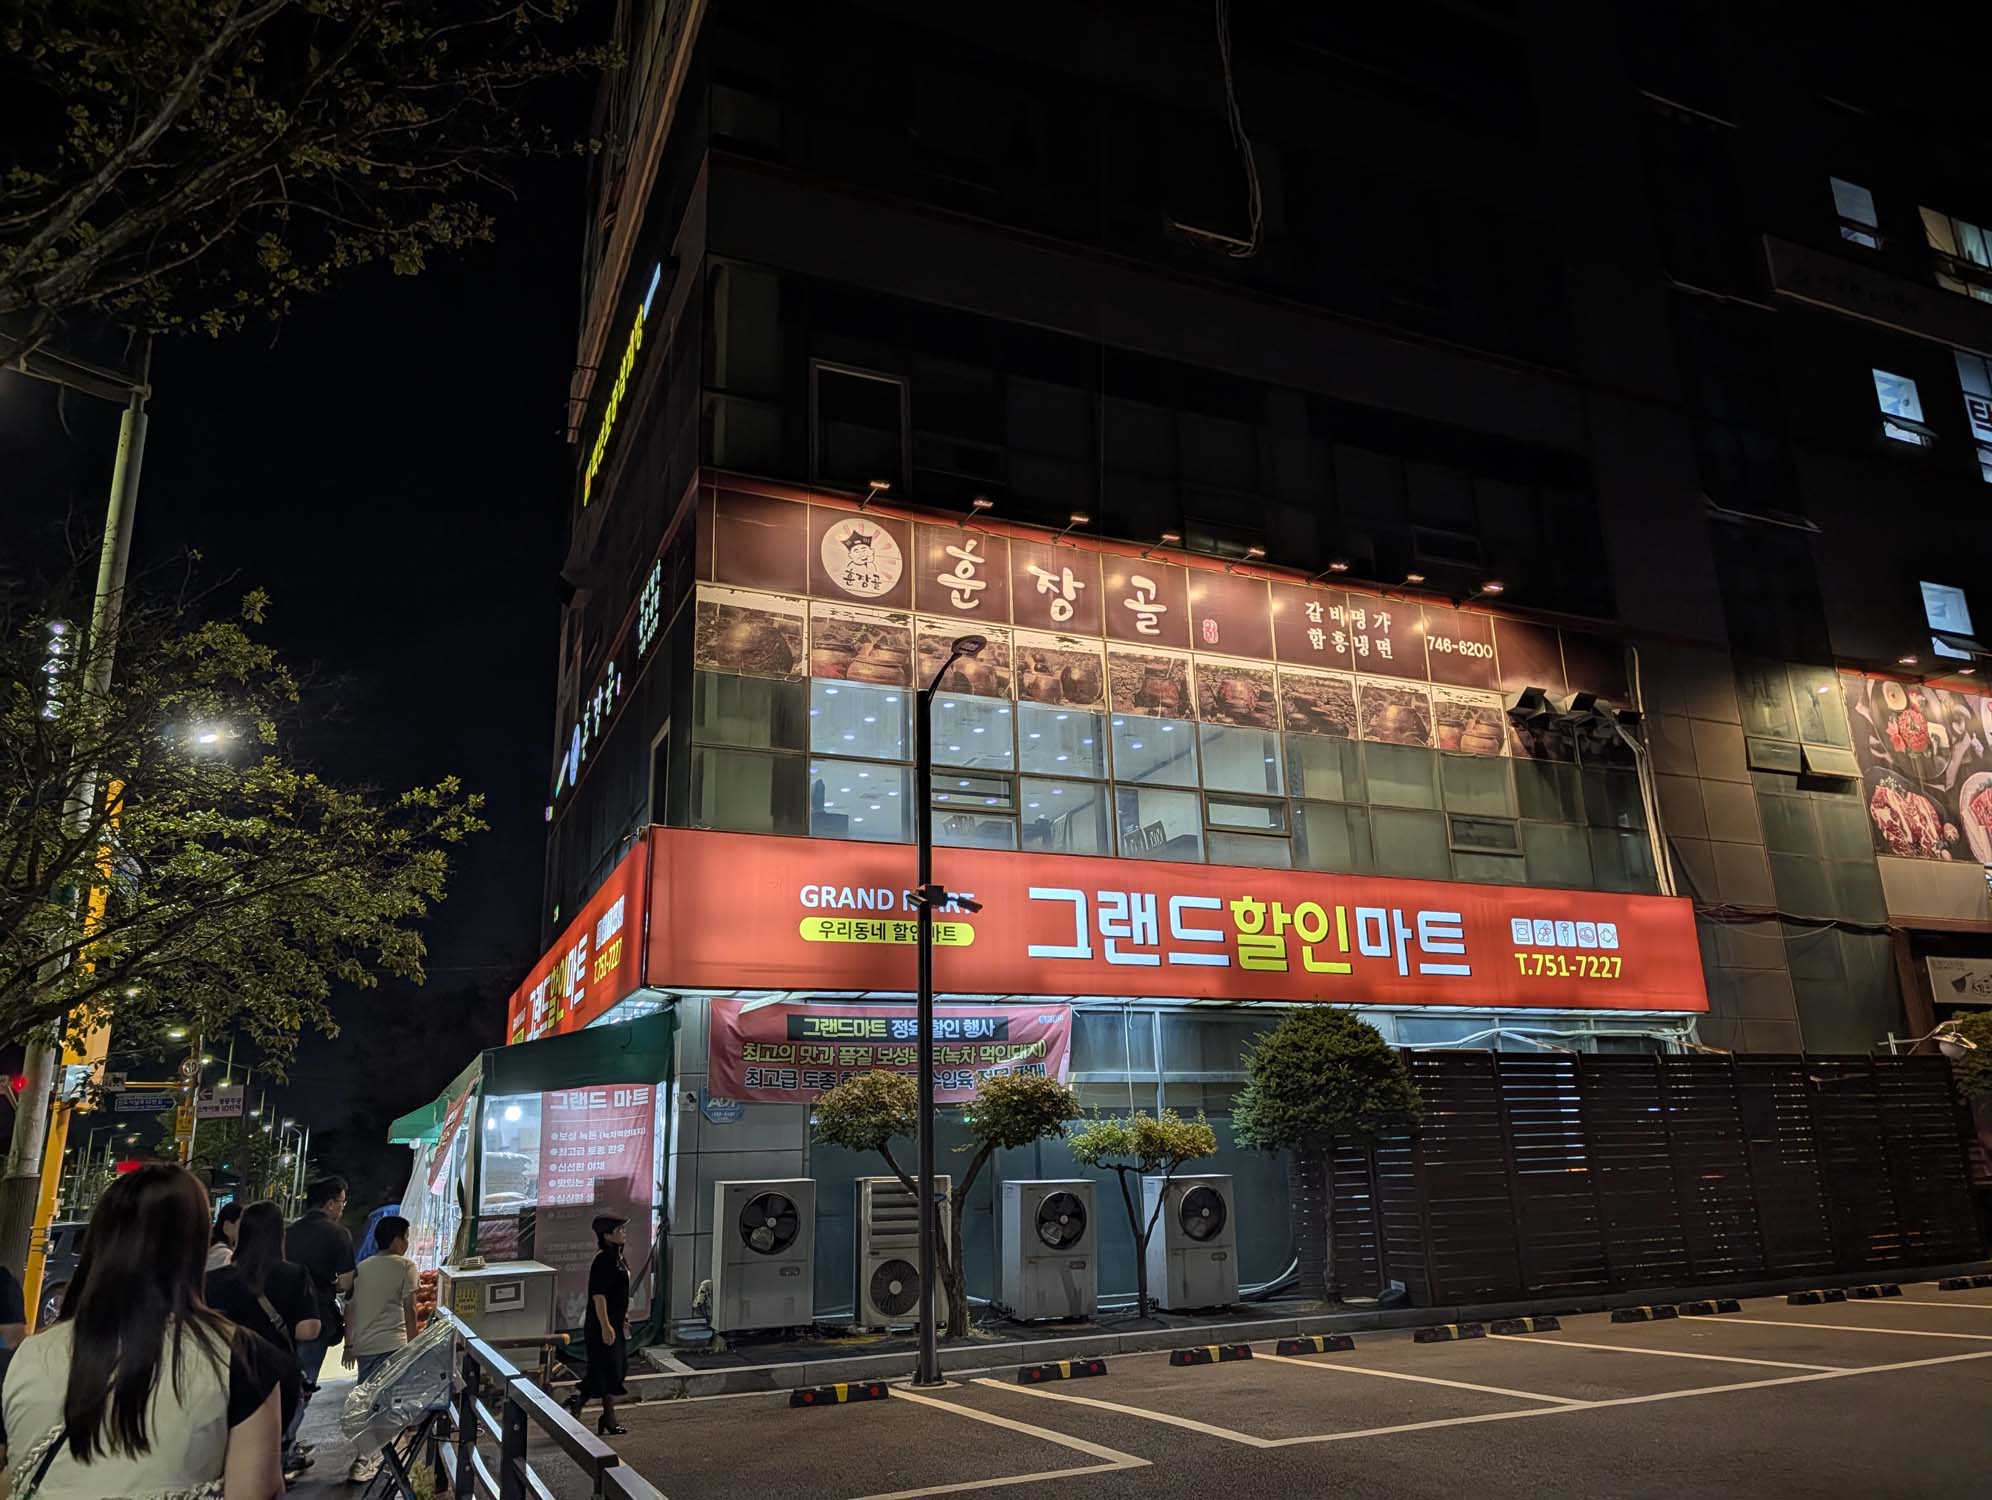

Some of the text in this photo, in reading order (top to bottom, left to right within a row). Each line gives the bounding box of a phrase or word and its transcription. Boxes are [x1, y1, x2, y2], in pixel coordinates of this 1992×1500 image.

[843, 568, 882, 591] 훈장골
[937, 539, 1168, 635] 훈장골
[1305, 601, 1392, 634] 갈비명가
[1307, 628, 1393, 659] 함흥냉면
[1426, 635, 1493, 660] 746-6200
[799, 884, 977, 914] GRAND MRT
[819, 921, 887, 941] 우리동네
[1028, 887, 1472, 977] 그랜드할인마트
[1514, 952, 1623, 979] T.751-7227
[802, 1017, 888, 1038] 그랜드마트
[932, 1018, 960, 1038] 할인
[962, 1018, 996, 1038] 행사
[743, 1042, 796, 1064] 최고의
[799, 1045, 835, 1066] 맛과
[838, 1046, 873, 1067] 품질
[745, 1067, 798, 1089] 최고급
[801, 1070, 837, 1090] 토종
[550, 1087, 649, 1110] 그랜드 마트
